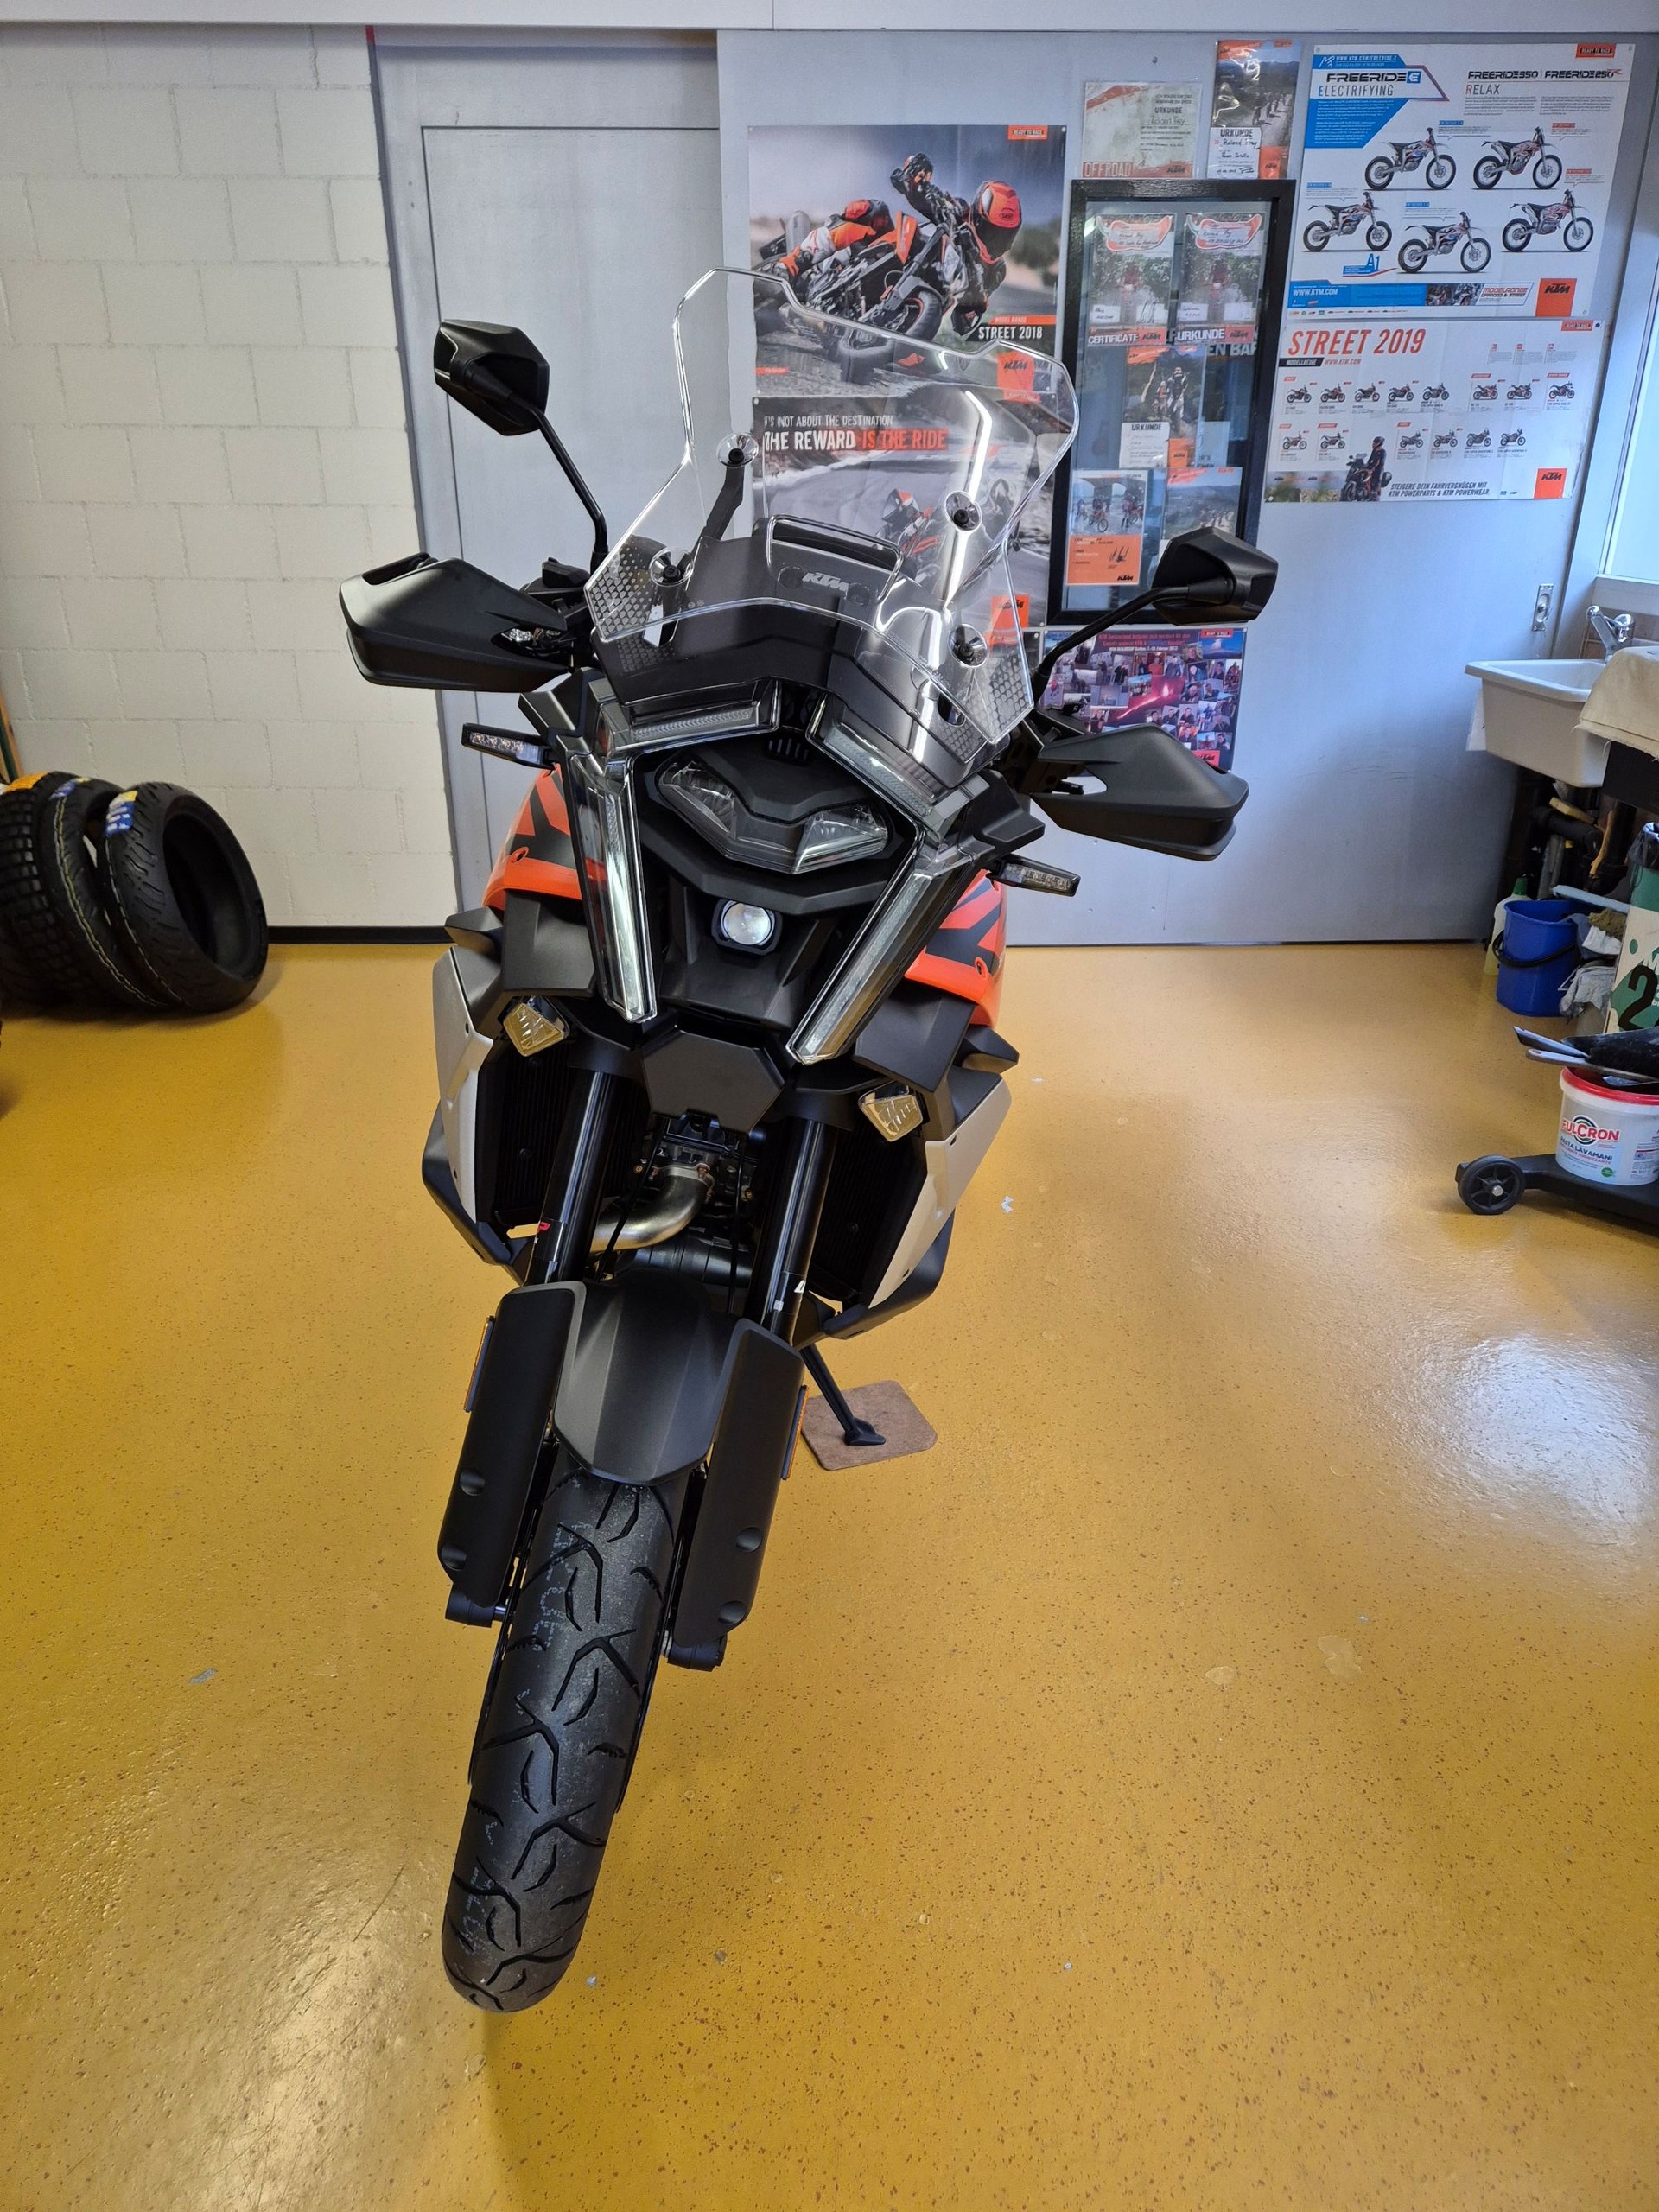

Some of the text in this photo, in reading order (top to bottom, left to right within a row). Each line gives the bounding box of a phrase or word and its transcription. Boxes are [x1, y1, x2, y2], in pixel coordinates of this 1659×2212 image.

[1326, 73, 1407, 83] FREERIDE
[1318, 85, 1394, 97] ELECTRIFYING
[1465, 84, 1501, 95] RELAX
[1220, 128, 1254, 137] URKUNDE
[1365, 253, 1380, 271] A1
[1544, 283, 1571, 294] KTM
[978, 326, 1043, 340] STREET 2018
[1089, 334, 1139, 344] CERTIFICATE
[1177, 328, 1225, 341] URKUNDE
[1287, 328, 1427, 356] STREET 2019
[778, 416, 794, 427] NOT
[796, 415, 823, 427] ABOUT
[825, 415, 839, 427] THE
[842, 414, 893, 426] DESTINATION
[794, 430, 856, 451] REWARD
[861, 429, 876, 449] IS
[881, 429, 908, 449] THE
[912, 429, 948, 449] RIDE
[1541, 472, 1562, 481] KTM
[802, 572, 849, 592] KTM
[1560, 1120, 1620, 1141] FULCRON
[1575, 1145, 1613, 1161] LAVAMANI
